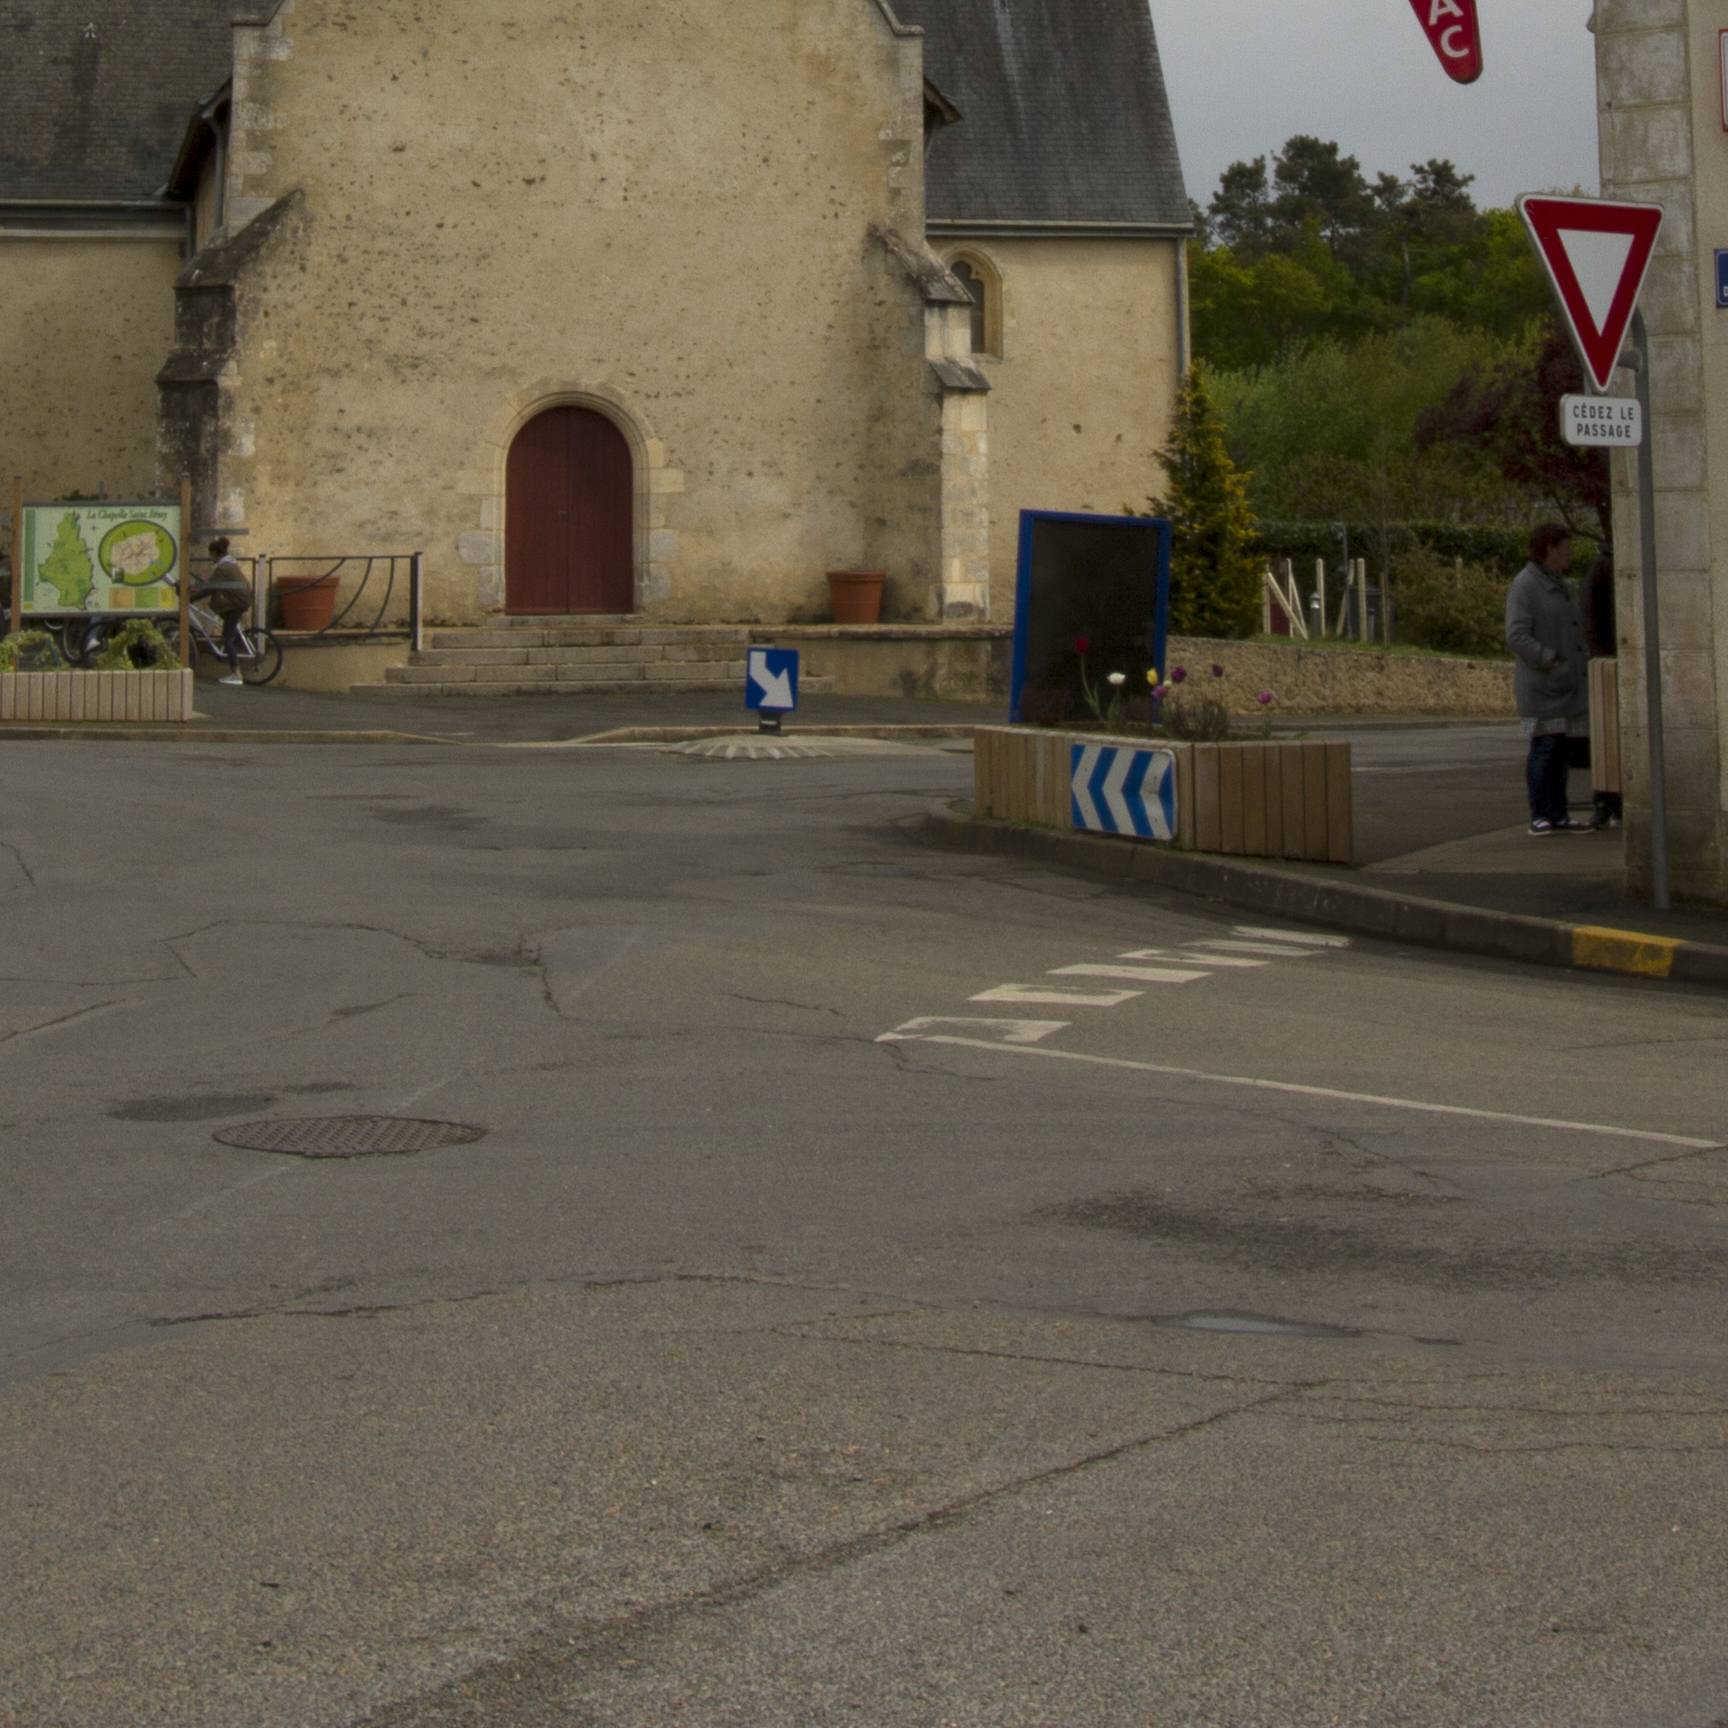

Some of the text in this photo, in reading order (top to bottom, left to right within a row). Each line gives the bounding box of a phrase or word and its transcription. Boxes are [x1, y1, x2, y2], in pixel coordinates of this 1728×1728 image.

[1573, 402, 1635, 421] CÉDEZ LE
[1576, 423, 1631, 438] PASSAGE
